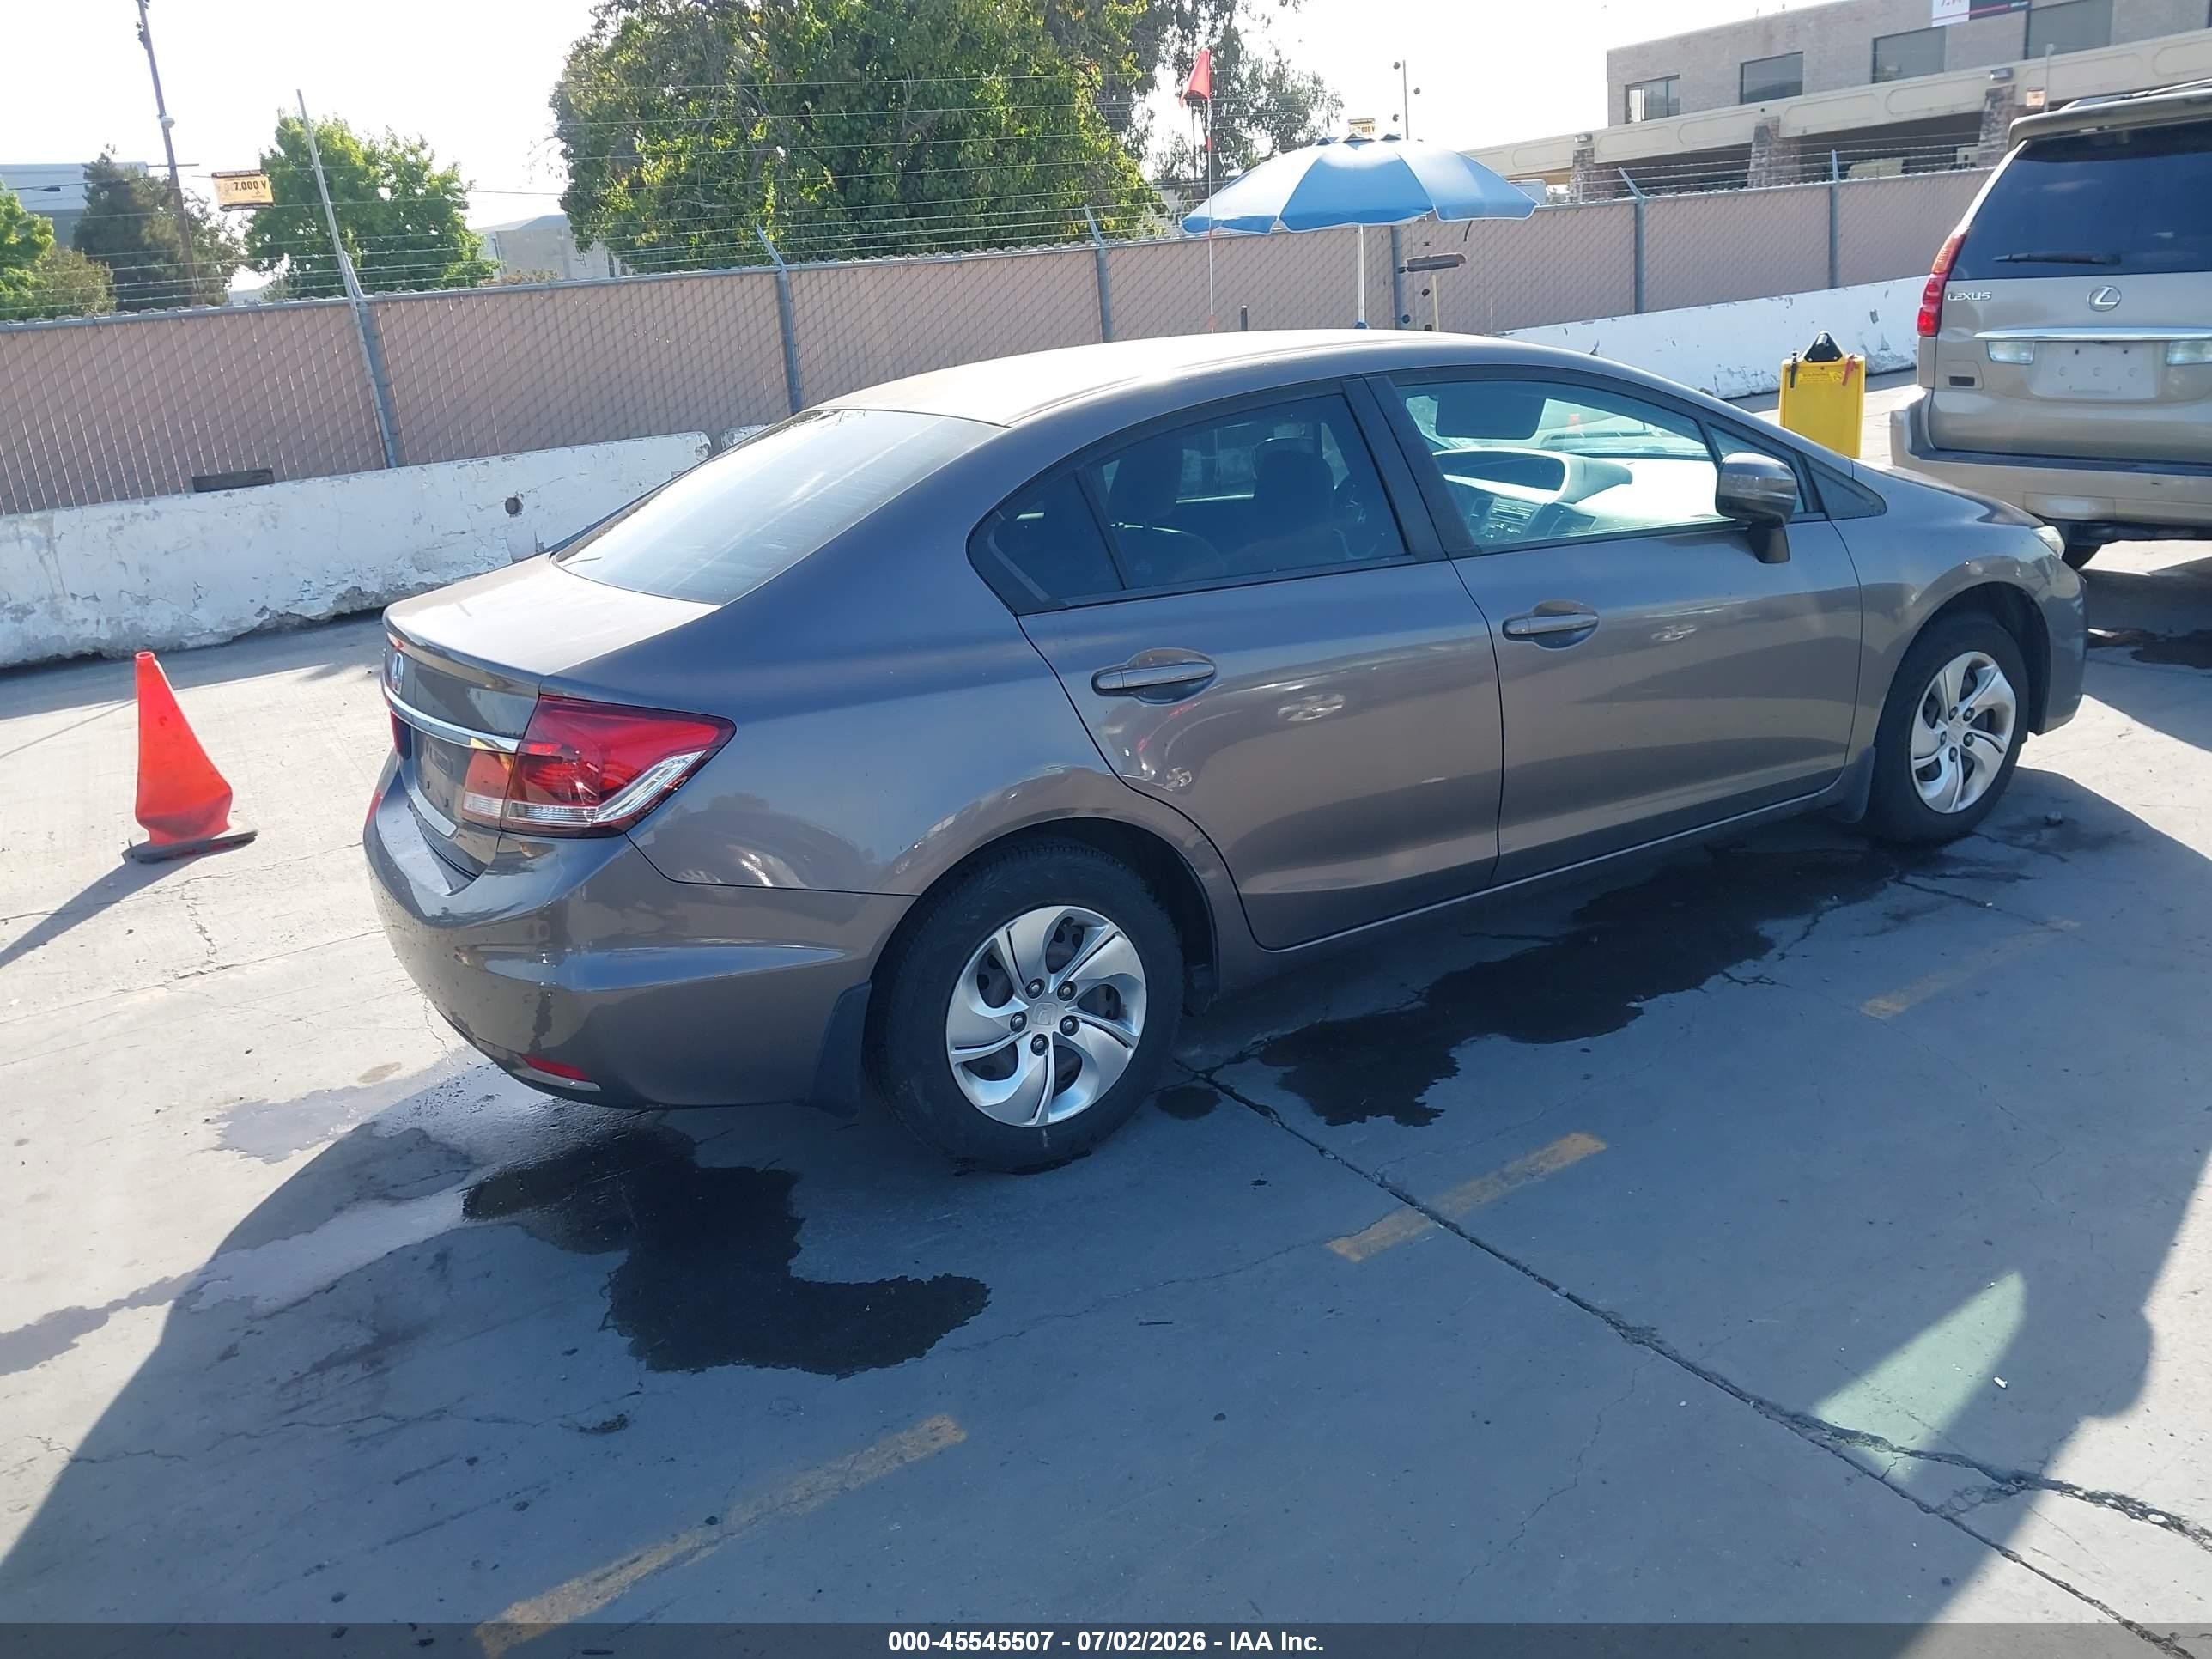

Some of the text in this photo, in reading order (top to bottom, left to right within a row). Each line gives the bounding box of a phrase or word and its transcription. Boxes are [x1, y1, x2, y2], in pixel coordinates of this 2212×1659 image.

[234, 181, 259, 191] 7,000
[260, 179, 266, 189] V
[1948, 291, 1991, 301] LEXUS
